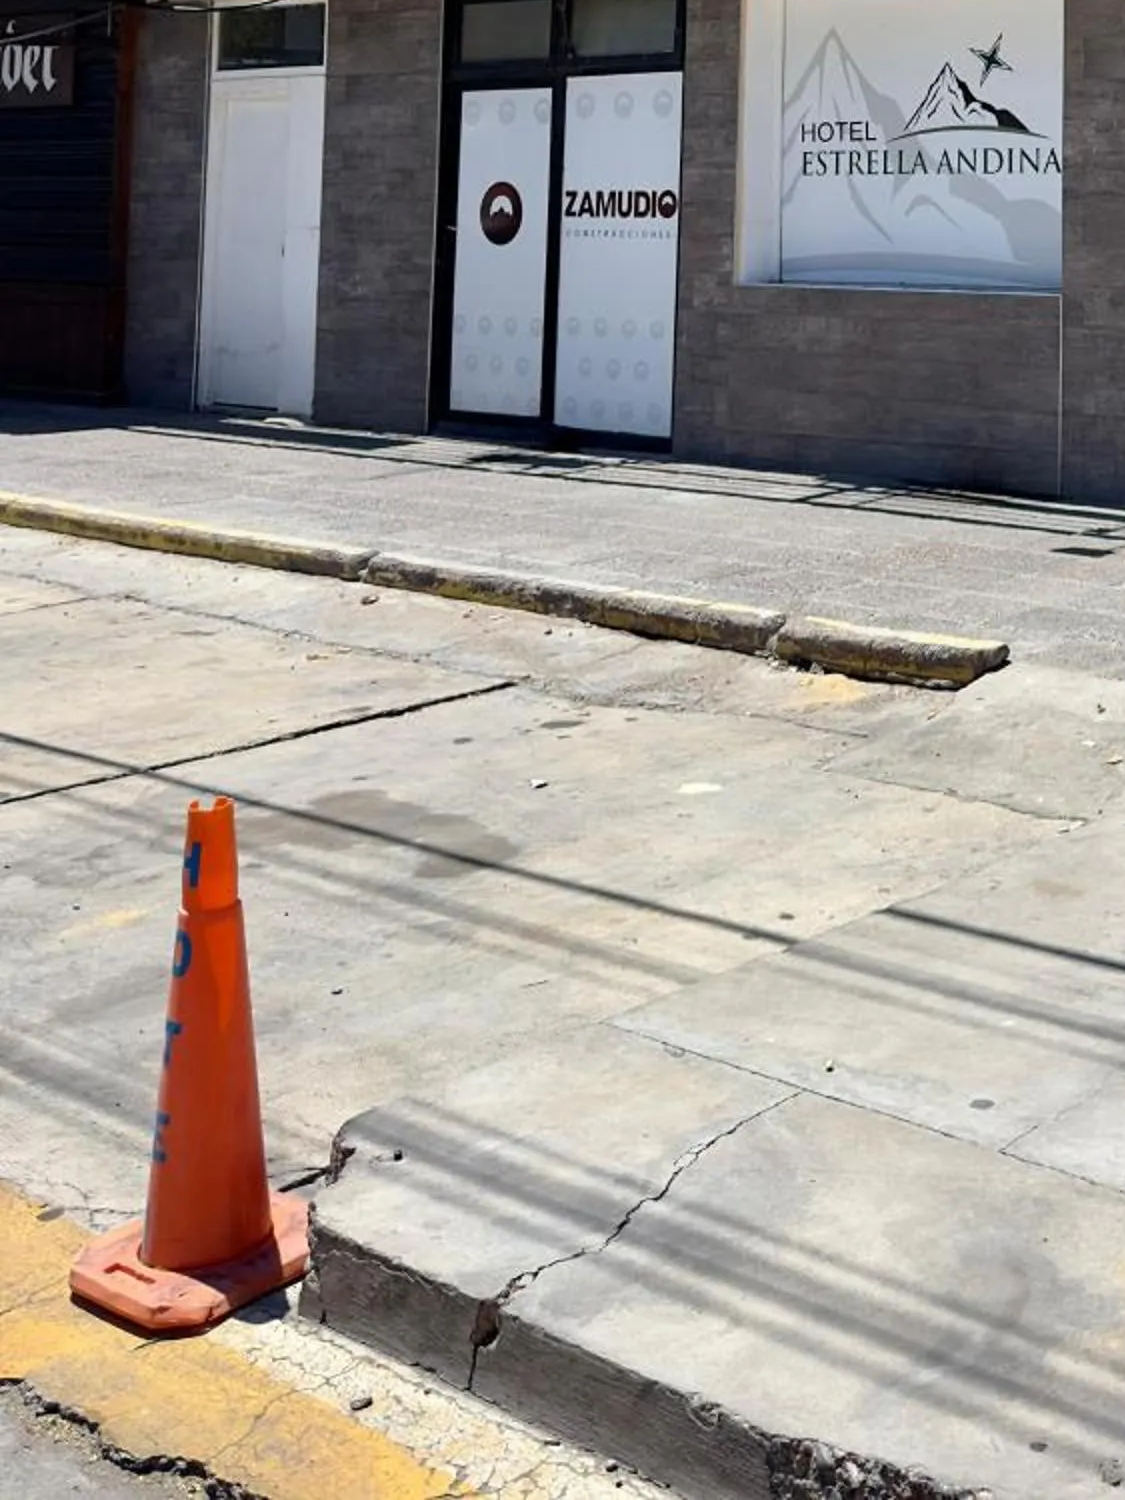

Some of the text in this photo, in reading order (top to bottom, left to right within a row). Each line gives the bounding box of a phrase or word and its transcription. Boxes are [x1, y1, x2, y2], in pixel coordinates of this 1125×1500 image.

[801, 121, 877, 143] HOTEL
[801, 147, 1062, 177] ESTRELLA ANDINA
[564, 189, 677, 219] ZAMUDIO
